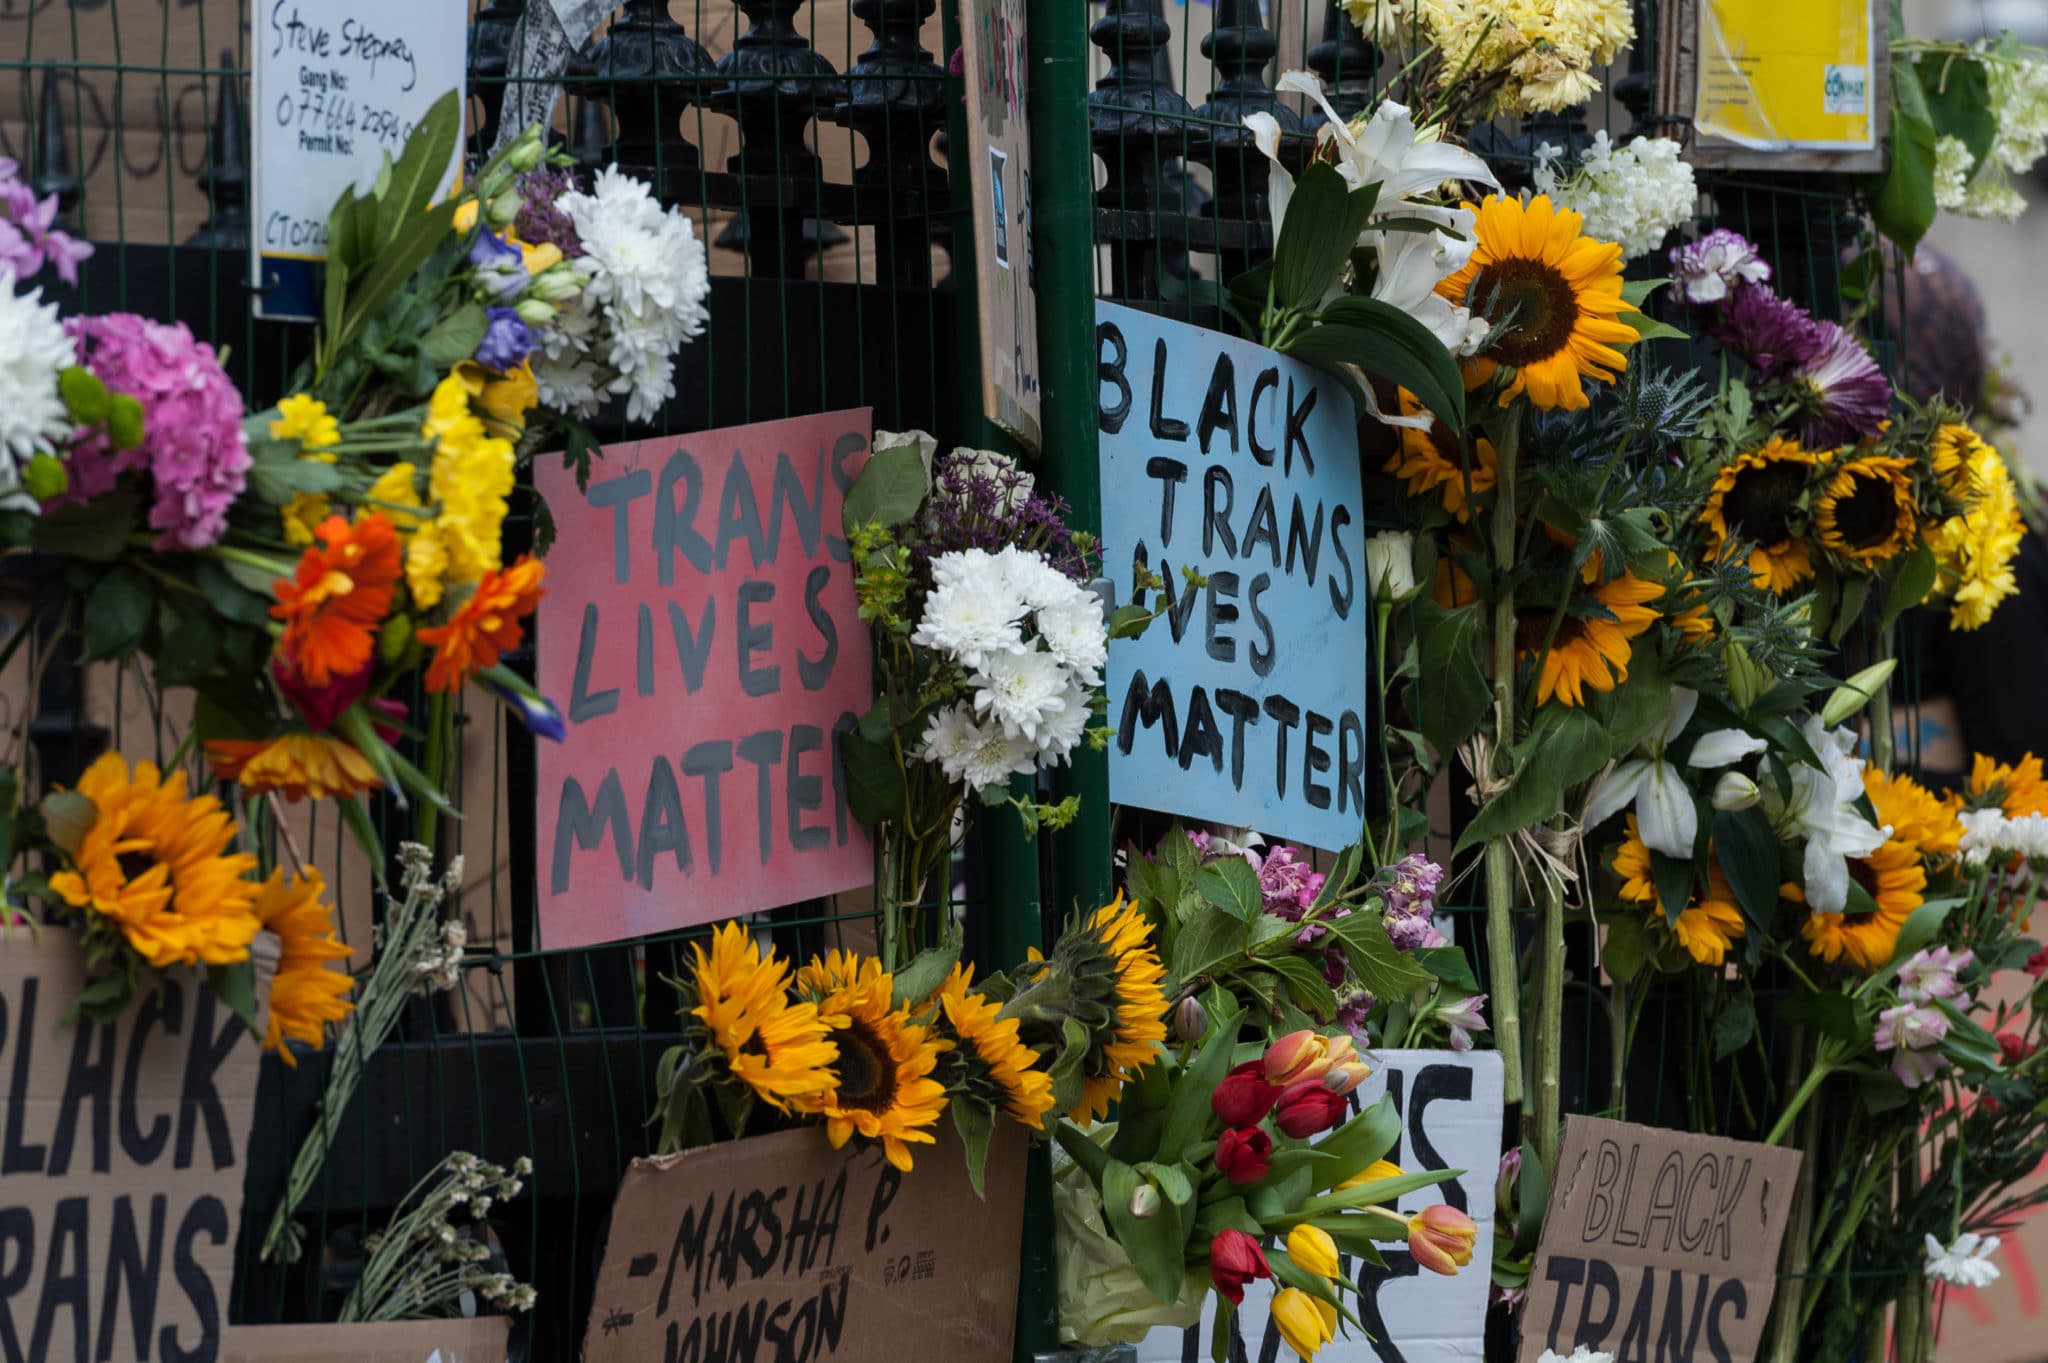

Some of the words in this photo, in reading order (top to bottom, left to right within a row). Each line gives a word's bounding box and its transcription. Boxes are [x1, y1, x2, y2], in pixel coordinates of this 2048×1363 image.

[271, 0, 331, 58] Steve
[299, 65, 328, 94] Gang
[299, 129, 333, 153] Permit
[1097, 321, 1318, 478] BLACK
[587, 432, 868, 588] TRANS
[1146, 456, 1354, 620] TRANS
[568, 565, 839, 723] LIVES
[1114, 537, 1276, 678] IVES
[1117, 668, 1365, 818] MATTER
[0, 976, 252, 1177] LACK
[1582, 1138, 1751, 1261] BLACK
[0, 1194, 230, 1363] RANS
[1545, 1255, 1748, 1363] TRANS
